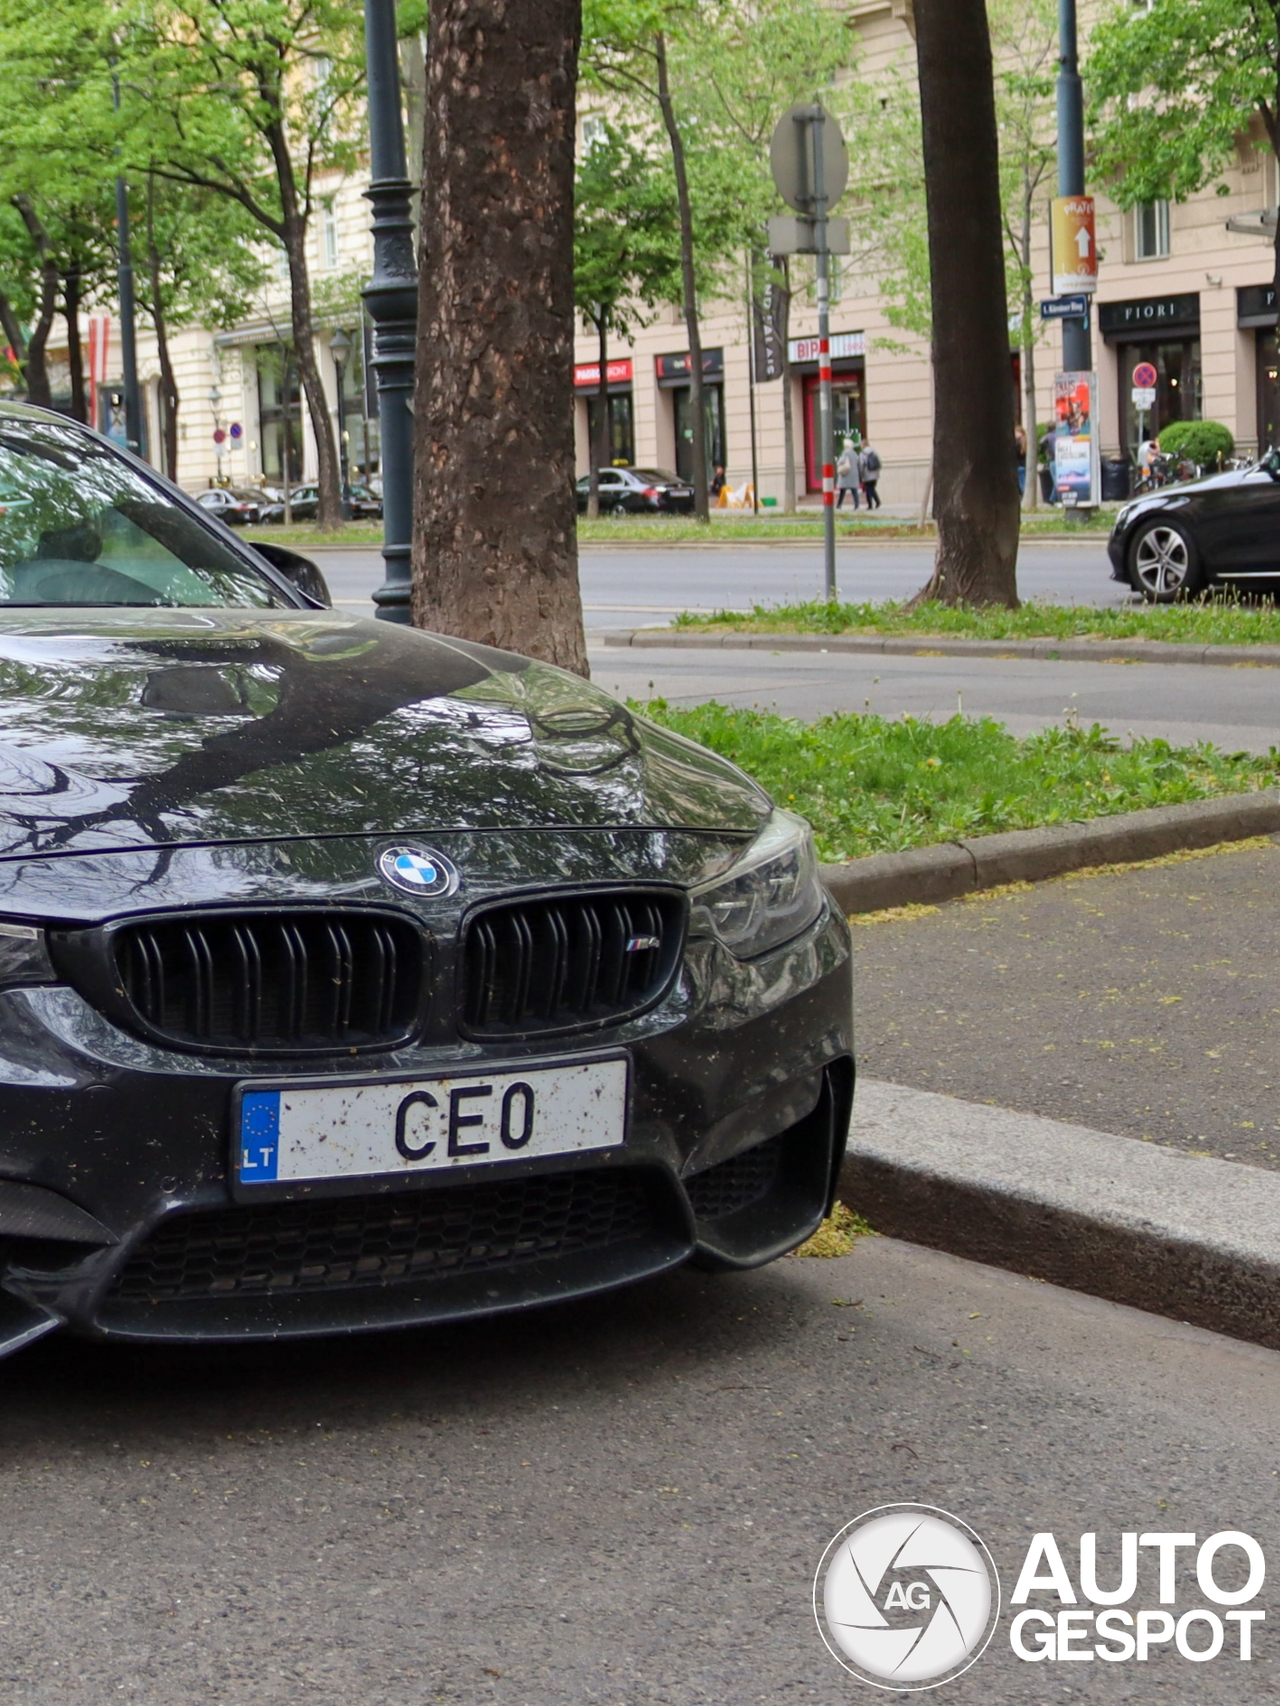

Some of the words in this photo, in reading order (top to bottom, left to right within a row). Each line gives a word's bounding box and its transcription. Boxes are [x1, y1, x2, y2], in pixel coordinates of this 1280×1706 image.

[1125, 303, 1175, 320] FIORI
[797, 341, 821, 359] BIP
[243, 1146, 275, 1168] LT
